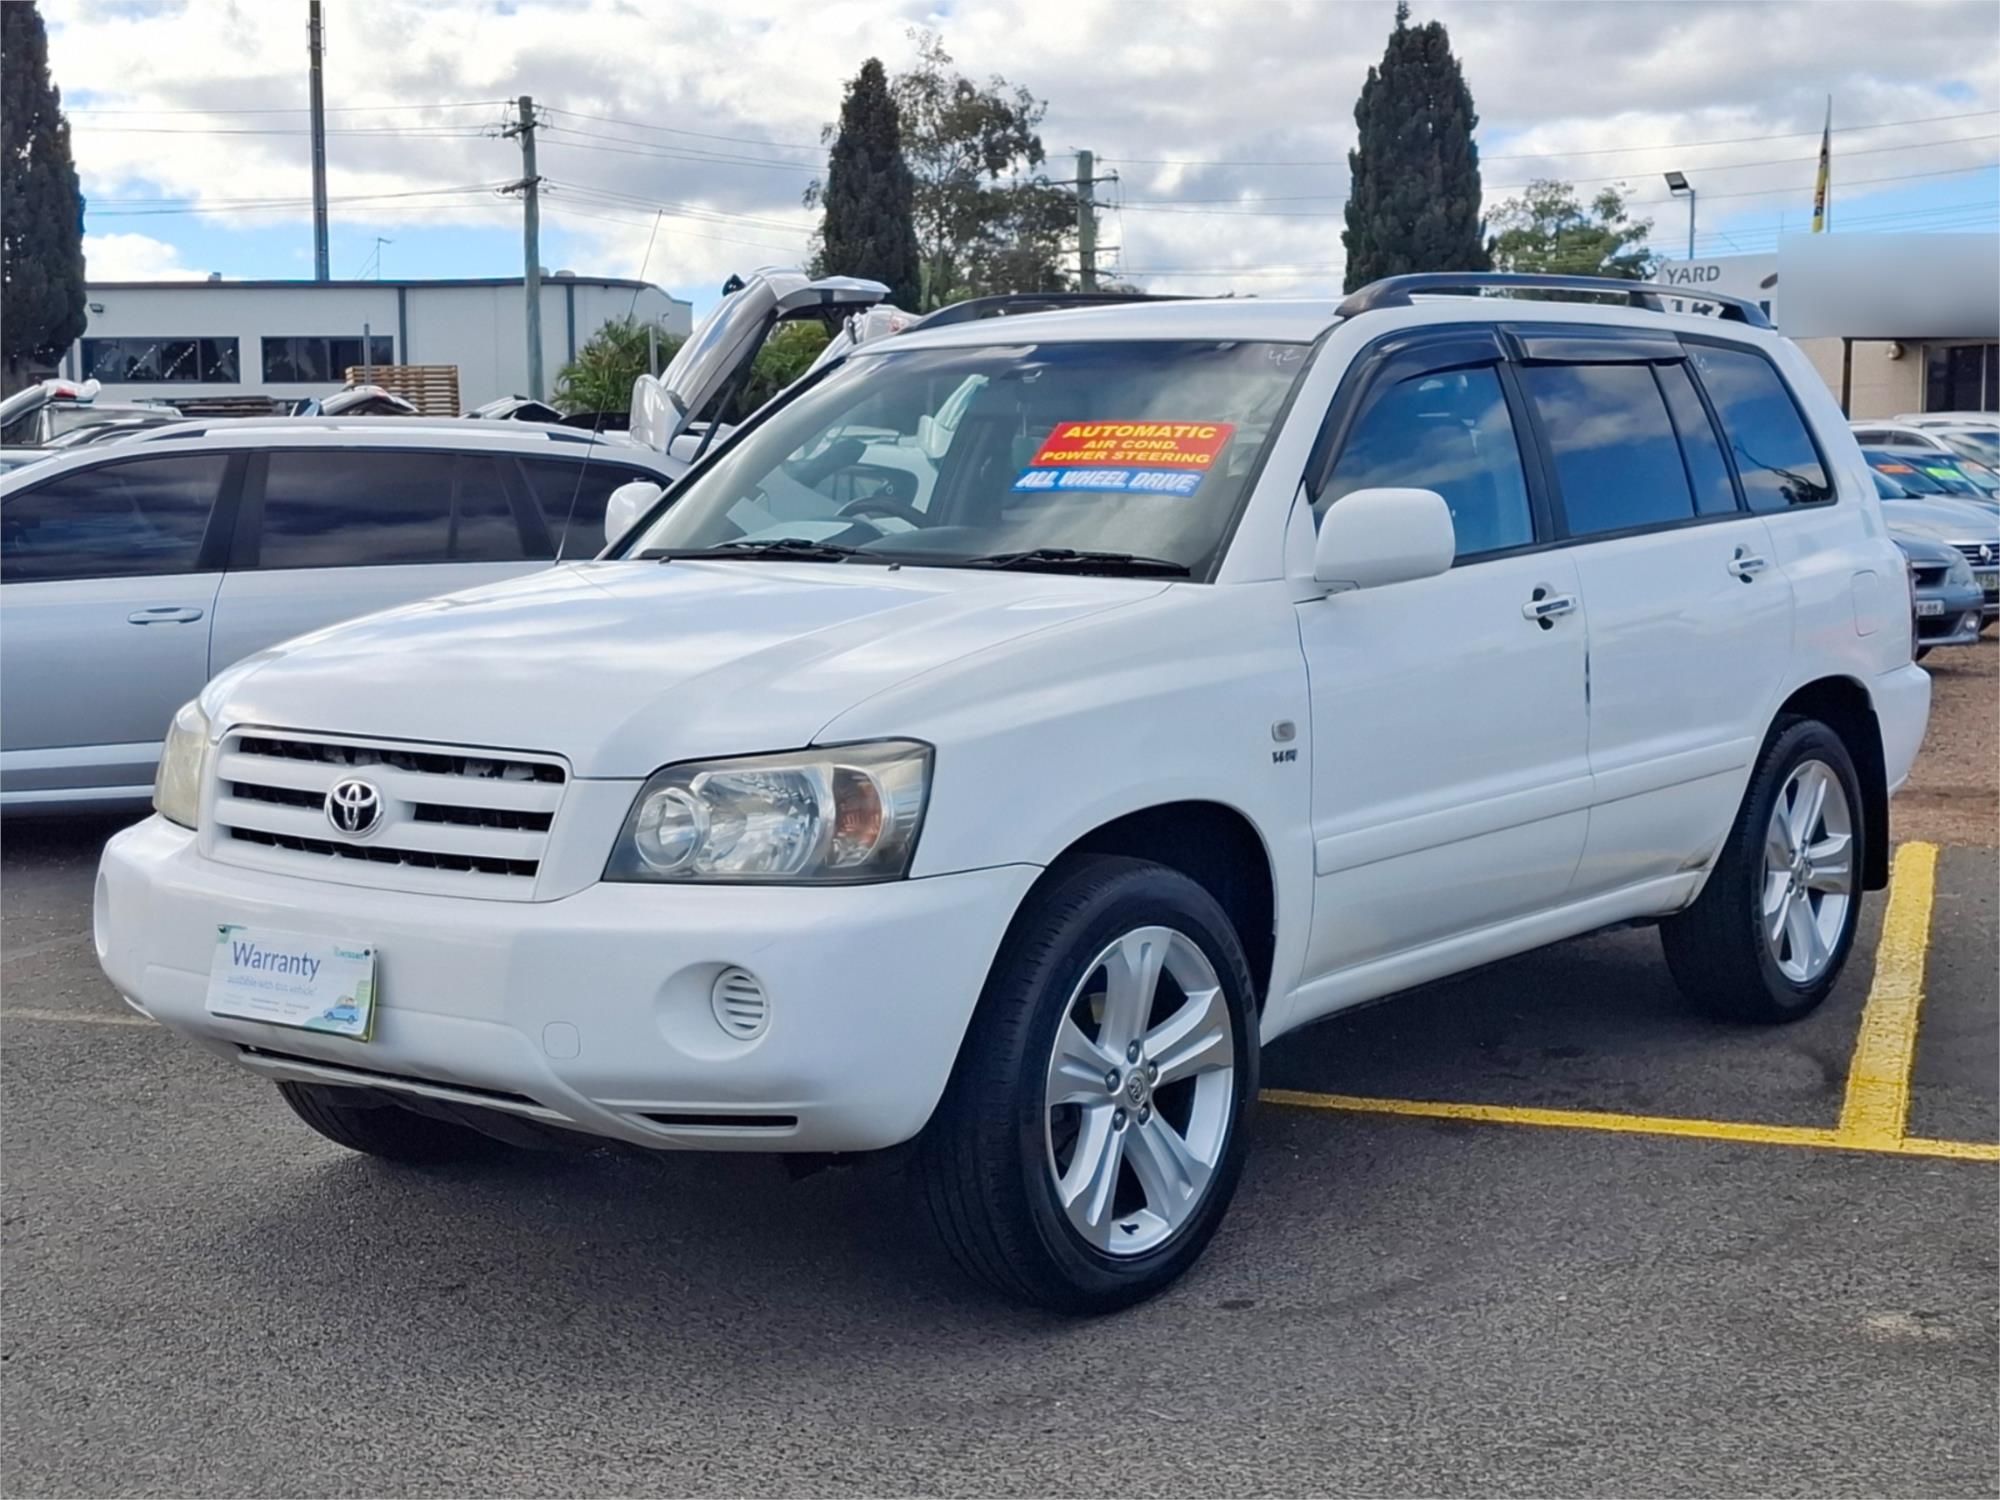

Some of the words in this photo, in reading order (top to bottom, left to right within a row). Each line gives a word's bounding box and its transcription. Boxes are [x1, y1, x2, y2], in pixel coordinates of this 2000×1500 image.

[1667, 265, 1720, 285] YARD
[1062, 424, 1217, 439] AUTOMATIC
[1083, 439, 1116, 450] AIR
[1121, 440, 1179, 450] COND.
[1040, 450, 1108, 461] POWER
[1111, 451, 1210, 464] STEERING
[1015, 470, 1056, 488] ALL
[1058, 470, 1130, 489] WHEEL
[1128, 471, 1200, 493] DRIVE
[232, 940, 321, 983] Warranty
